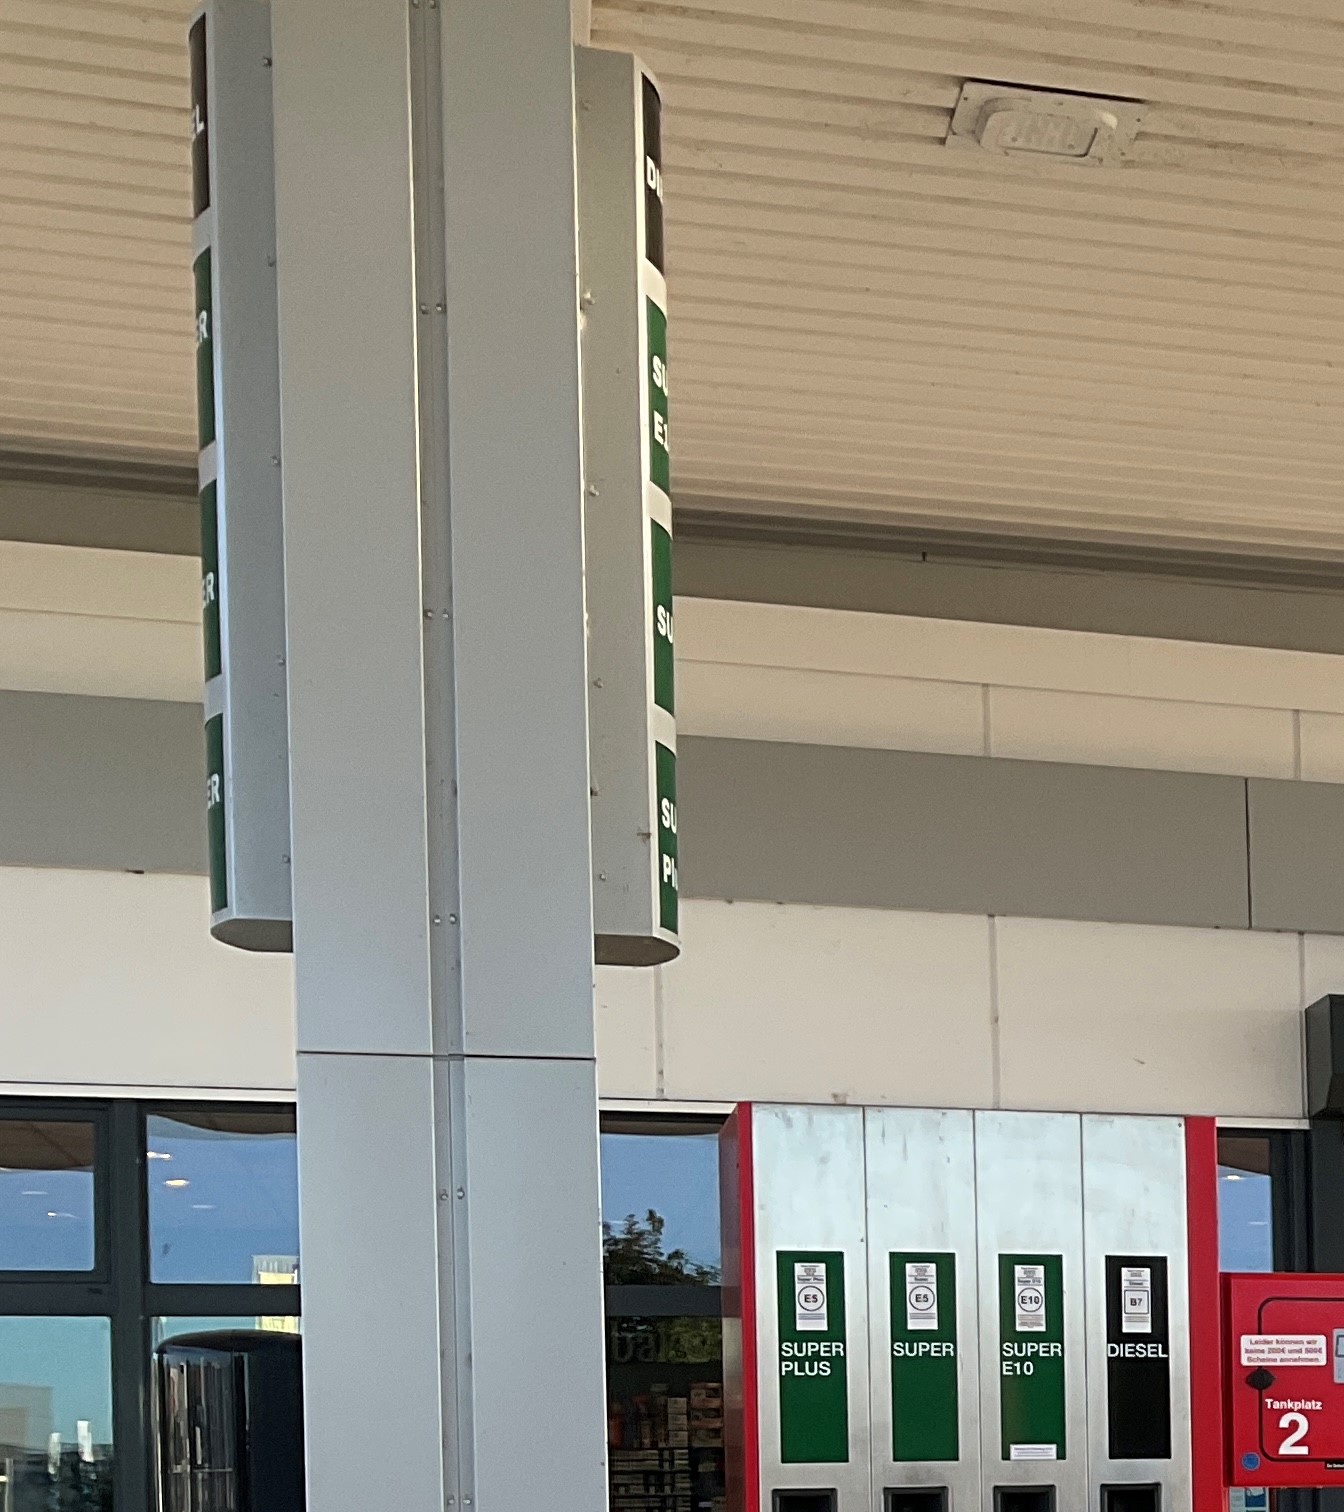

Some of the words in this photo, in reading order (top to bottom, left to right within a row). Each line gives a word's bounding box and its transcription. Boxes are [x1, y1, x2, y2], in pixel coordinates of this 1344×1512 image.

[804, 1293, 818, 1303] E5
[915, 1293, 929, 1303] E5
[1020, 1295, 1040, 1304] E10
[1130, 1297, 1142, 1306] B7
[781, 1341, 844, 1357] SUPER
[893, 1342, 954, 1357] SUPER
[1002, 1342, 1062, 1357] SUPER
[1107, 1343, 1168, 1358] DIESEL
[781, 1361, 831, 1376] PLUS
[1002, 1361, 1034, 1376] E10
[1265, 1398, 1322, 1411] Tankplatz
[1278, 1411, 1309, 1455] 2
